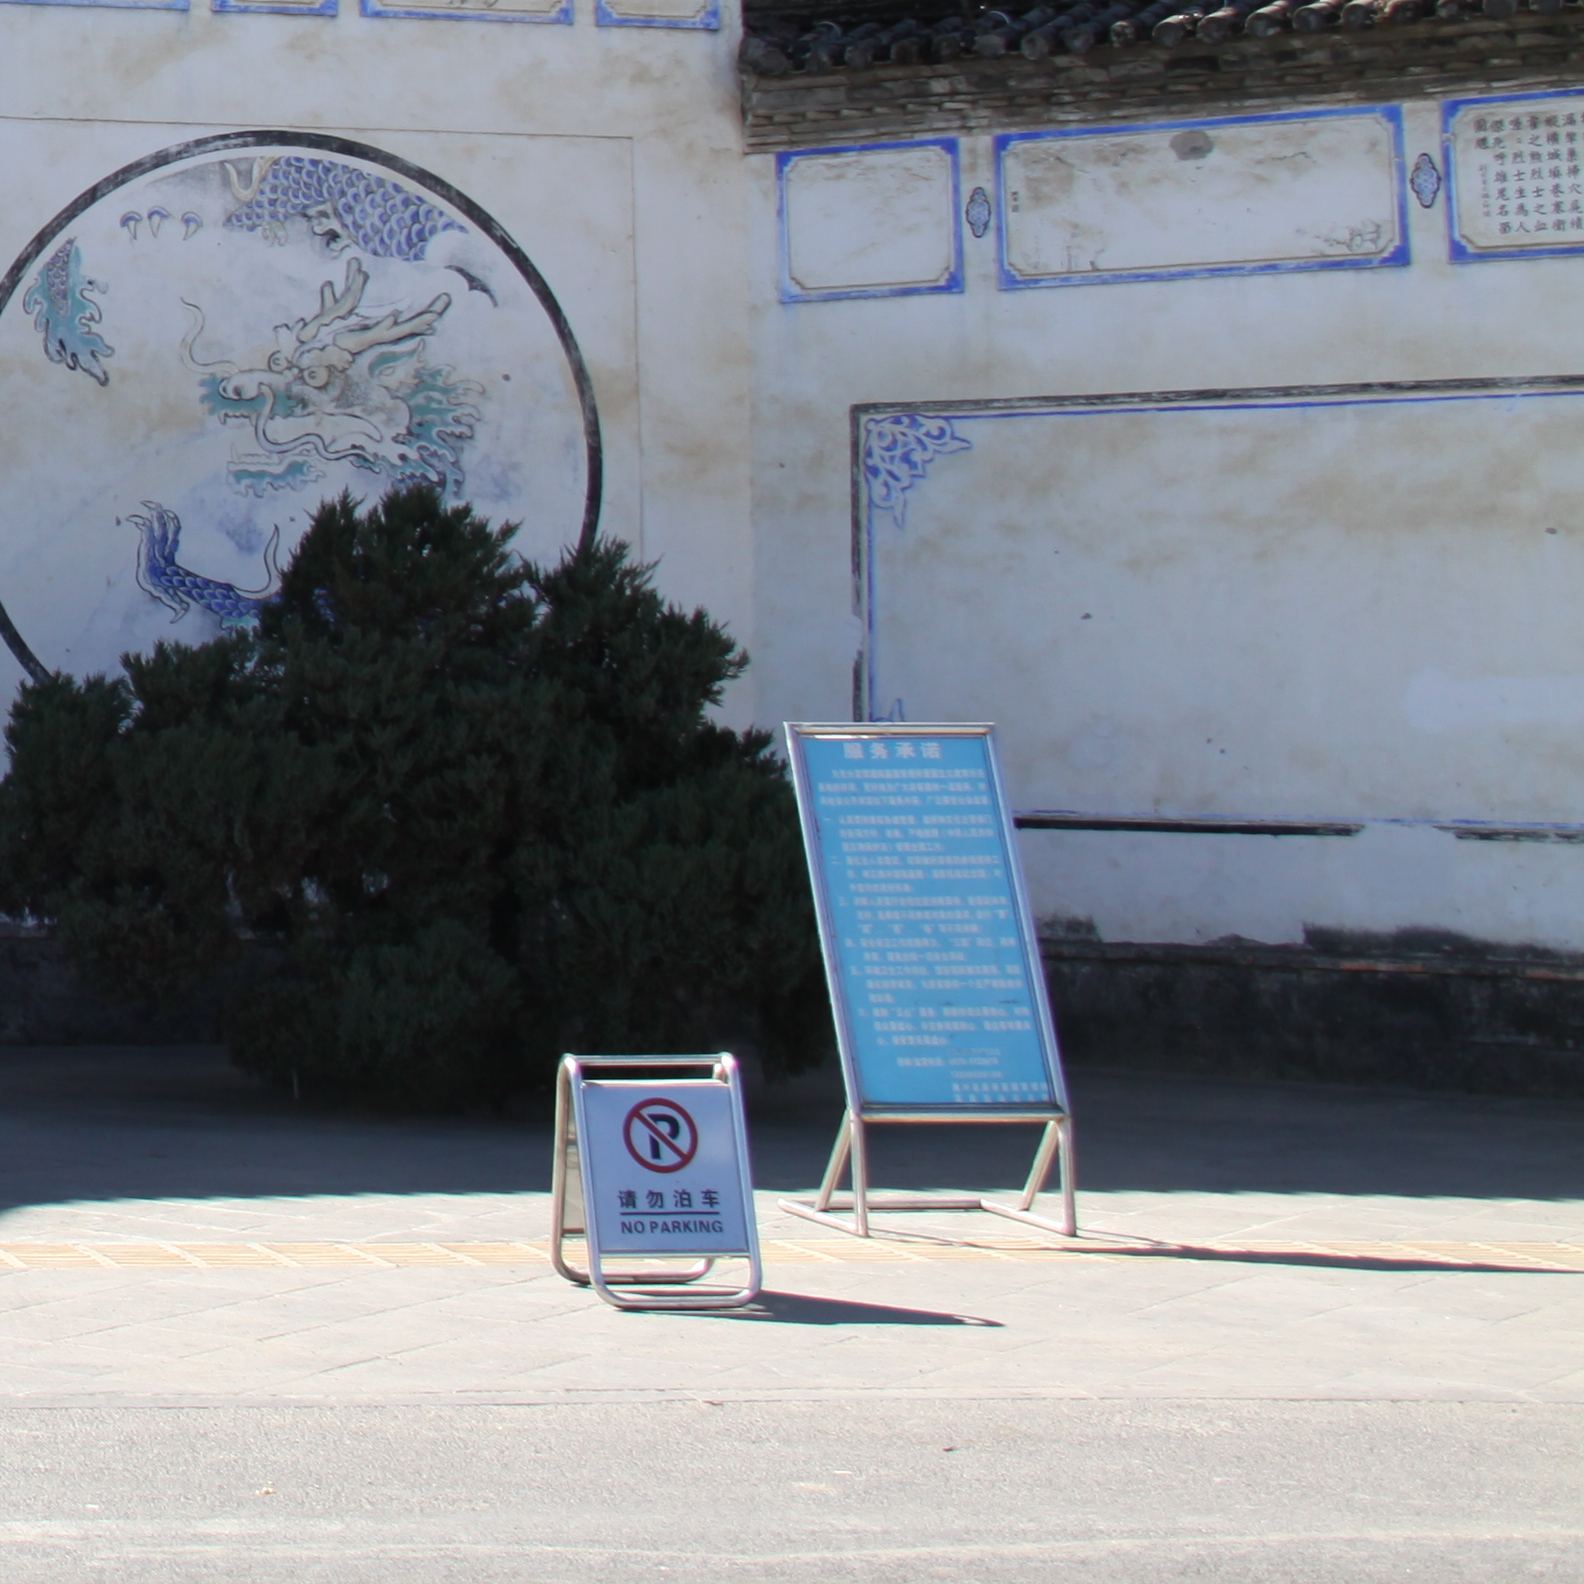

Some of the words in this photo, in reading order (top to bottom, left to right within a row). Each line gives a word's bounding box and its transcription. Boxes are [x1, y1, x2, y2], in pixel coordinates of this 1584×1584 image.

[843, 741, 943, 760] 服务承诺
[618, 1188, 720, 1209] 请勿泊车
[620, 1220, 645, 1234] NO
[649, 1219, 724, 1234] PARKING
